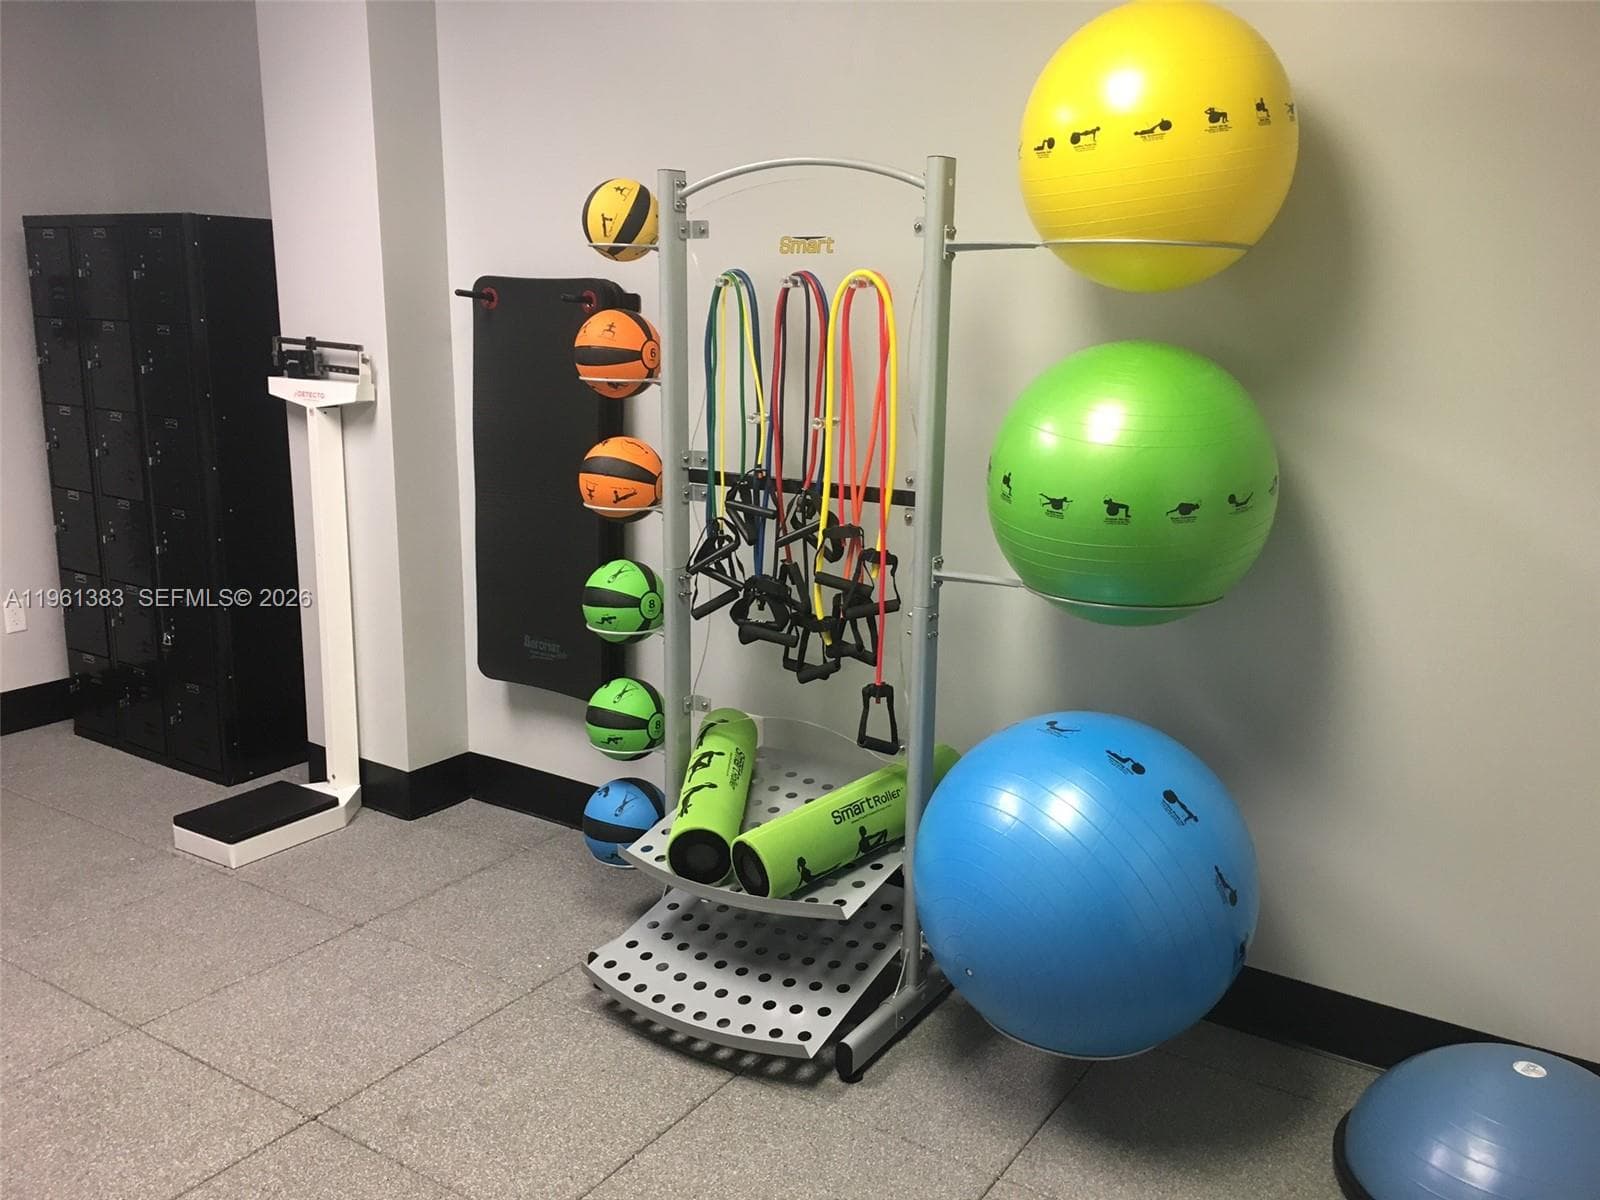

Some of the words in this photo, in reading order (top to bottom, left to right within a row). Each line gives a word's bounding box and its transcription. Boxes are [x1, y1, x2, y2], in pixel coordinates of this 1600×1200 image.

[779, 236, 834, 254] Smart
[650, 347, 656, 358] 6
[295, 390, 325, 400] DETECTO
[648, 599, 656, 608] 8
